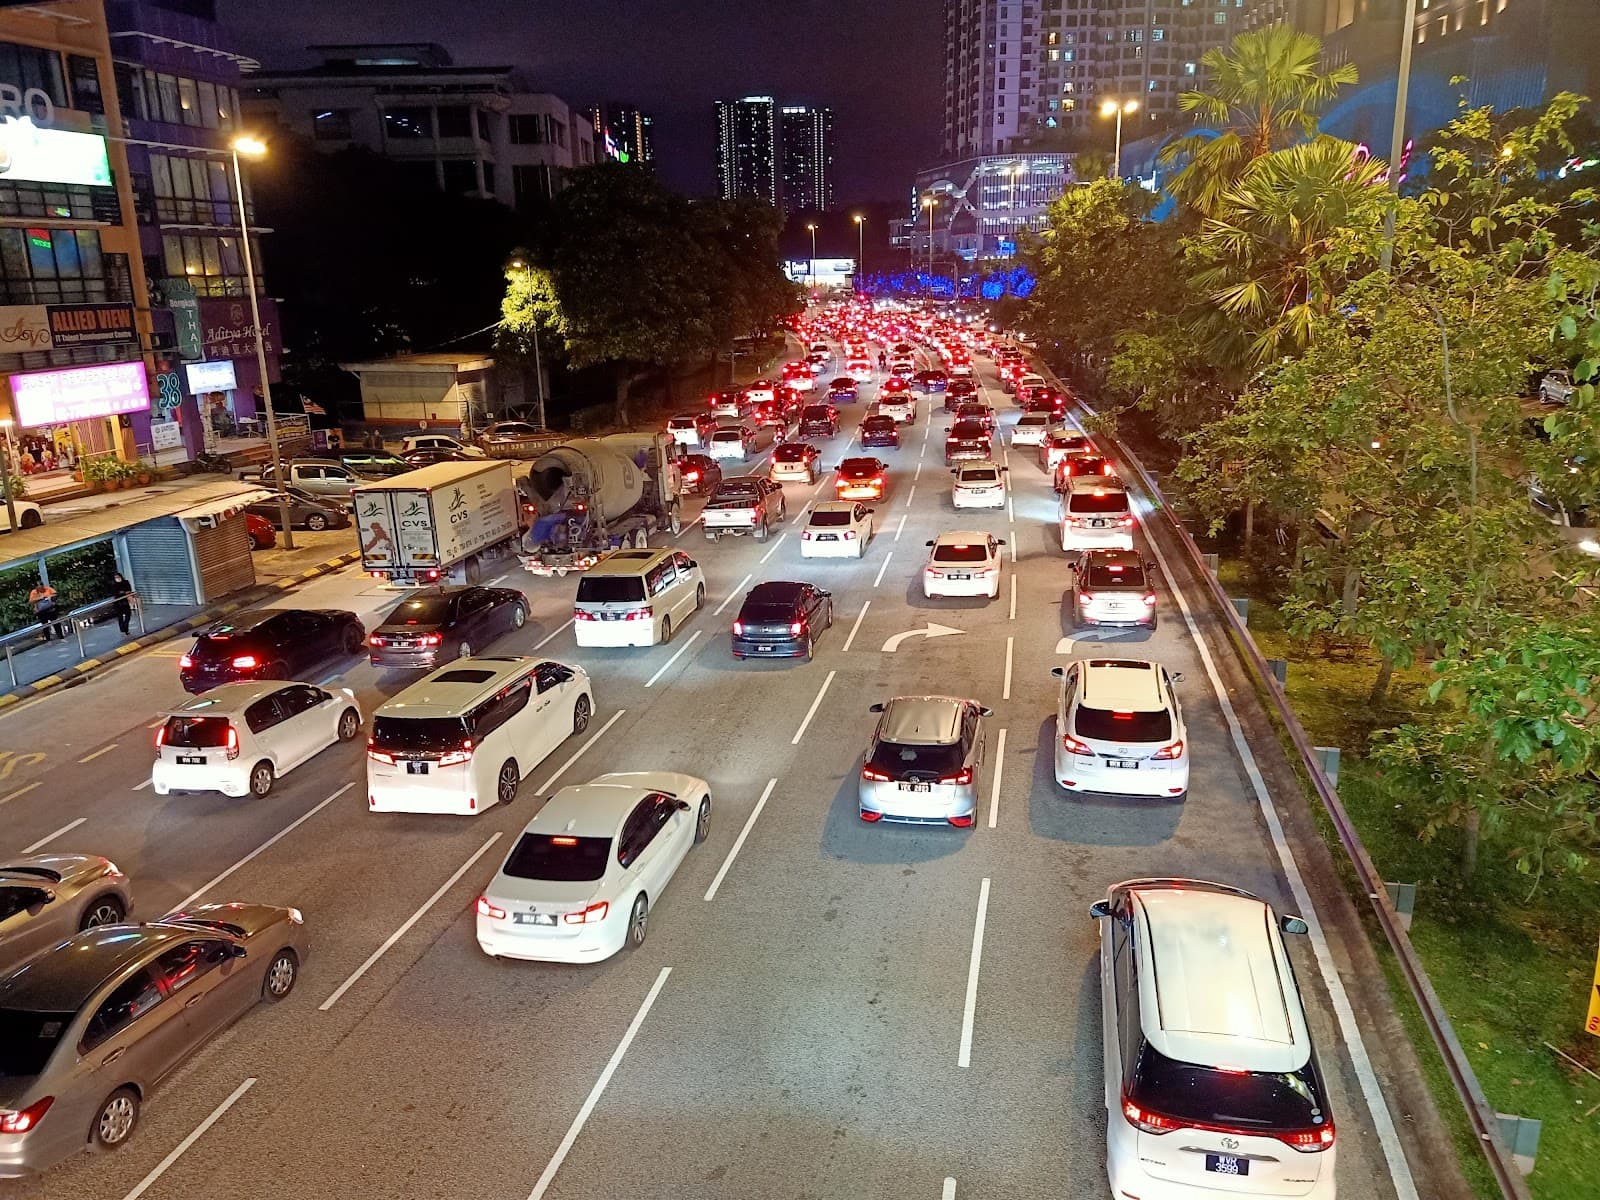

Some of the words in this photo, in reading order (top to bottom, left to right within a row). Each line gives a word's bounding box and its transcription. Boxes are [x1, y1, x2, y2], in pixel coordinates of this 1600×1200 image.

[52, 310, 97, 332] ALLIED
[97, 308, 131, 329] VIEW
[207, 326, 243, 343] Aditya
[243, 322, 272, 338] Hoel
[156, 371, 183, 409] 38
[402, 520, 428, 528] CVS
[450, 509, 468, 524] CVS
[1215, 1163, 1239, 1174] 3599
